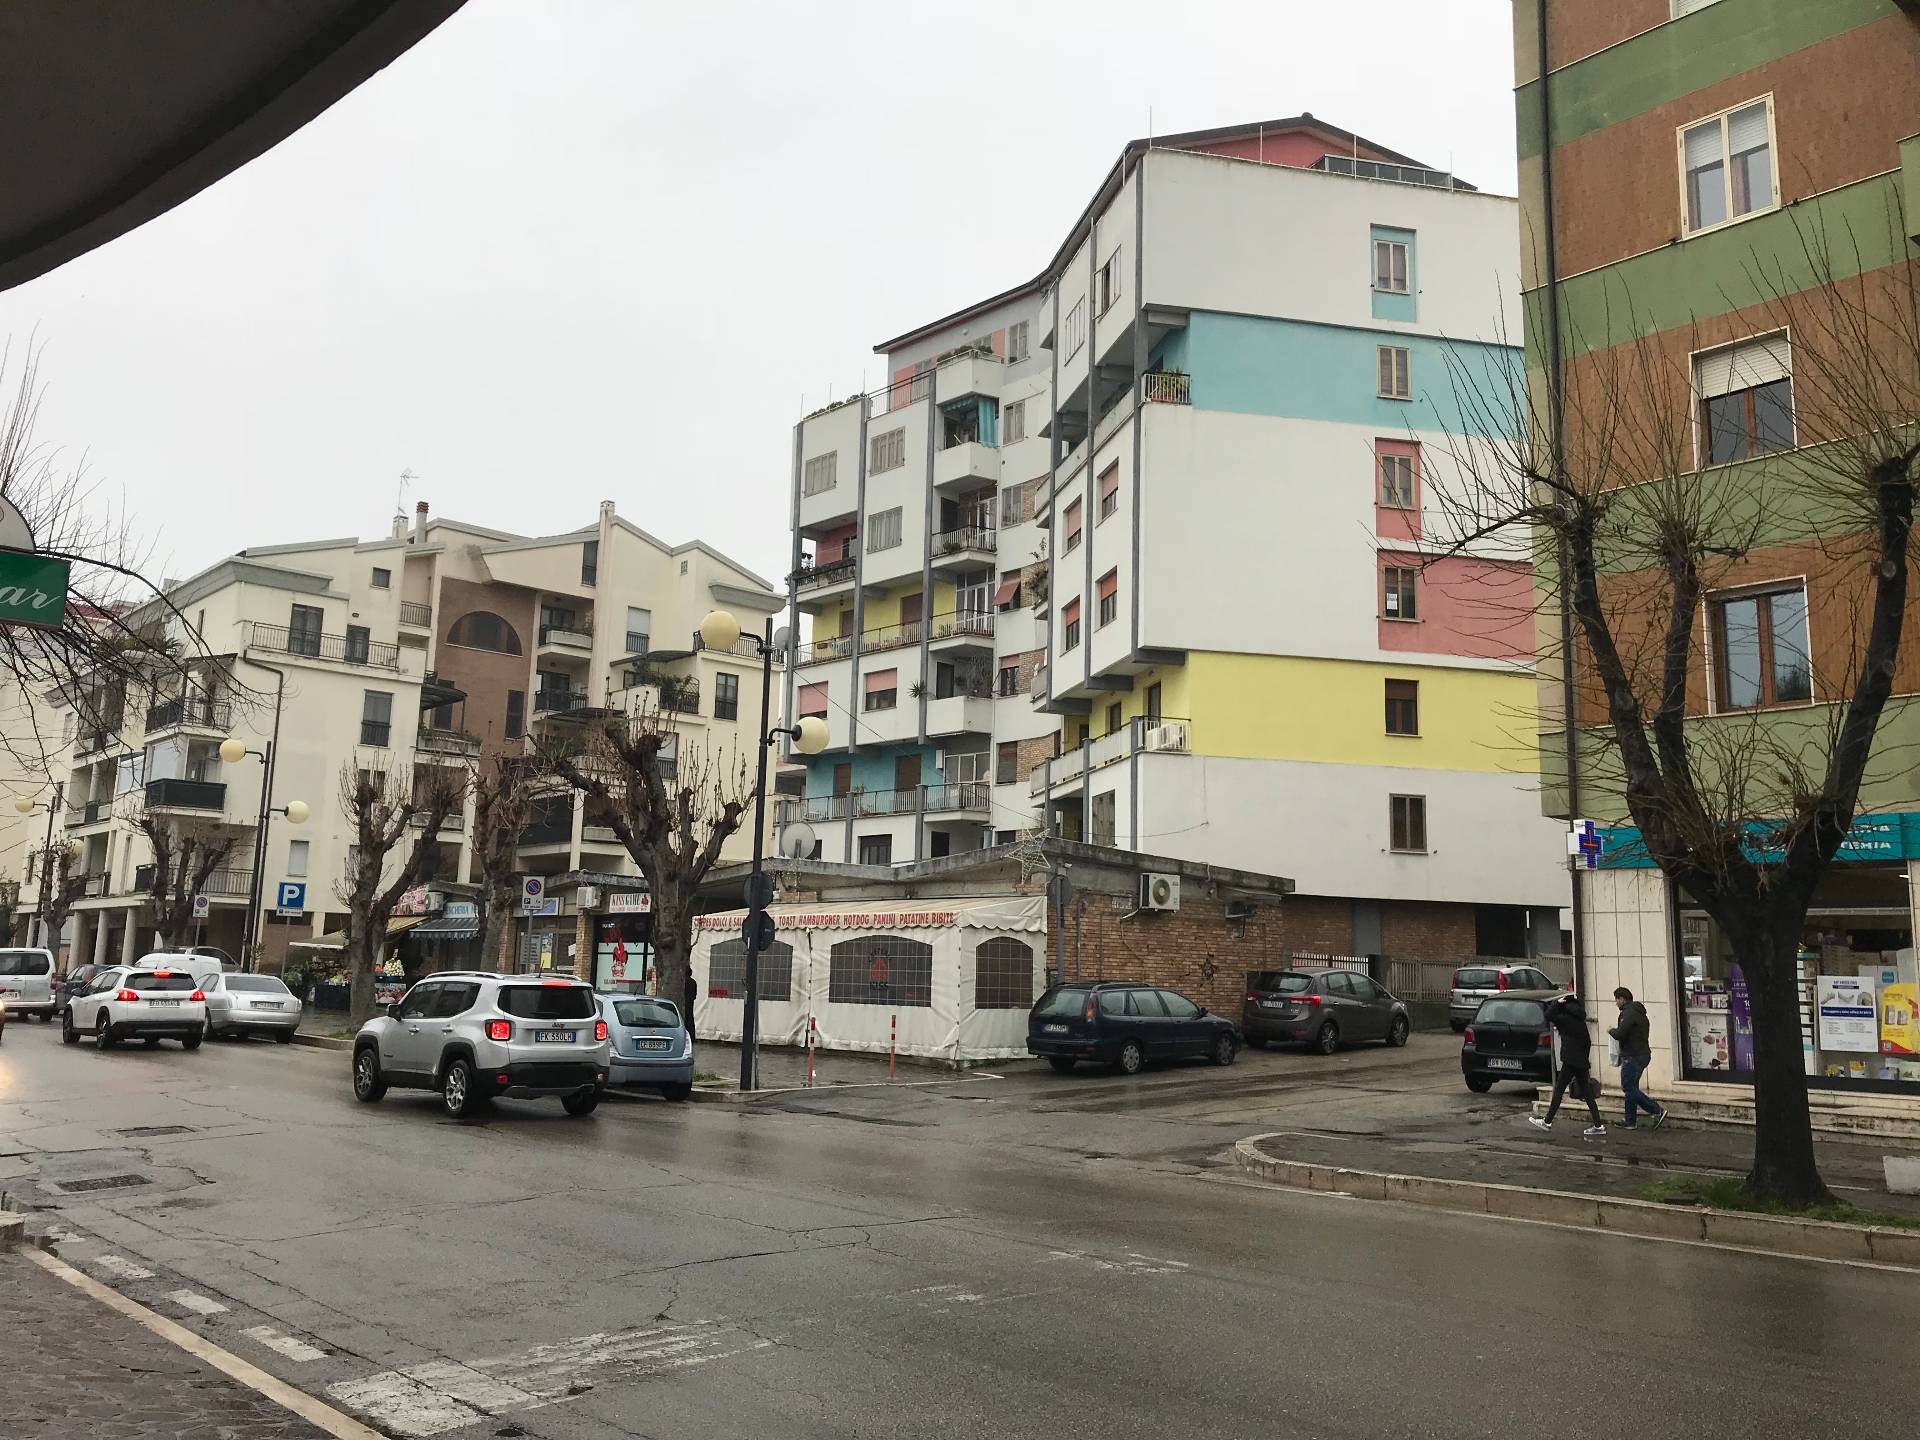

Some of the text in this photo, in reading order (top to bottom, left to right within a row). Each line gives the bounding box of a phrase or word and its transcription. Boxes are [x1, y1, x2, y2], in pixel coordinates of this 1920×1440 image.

[282, 884, 300, 905] P
[712, 916, 727, 927] DOLCI
[779, 915, 796, 926] TOAST
[799, 914, 840, 926] HAMBURGHER
[844, 914, 869, 925] HOTDOG
[873, 913, 896, 925] PANINI
[900, 912, 929, 924] PATATINE
[932, 912, 954, 924] BIBITE
[540, 1032, 549, 1040] FK
